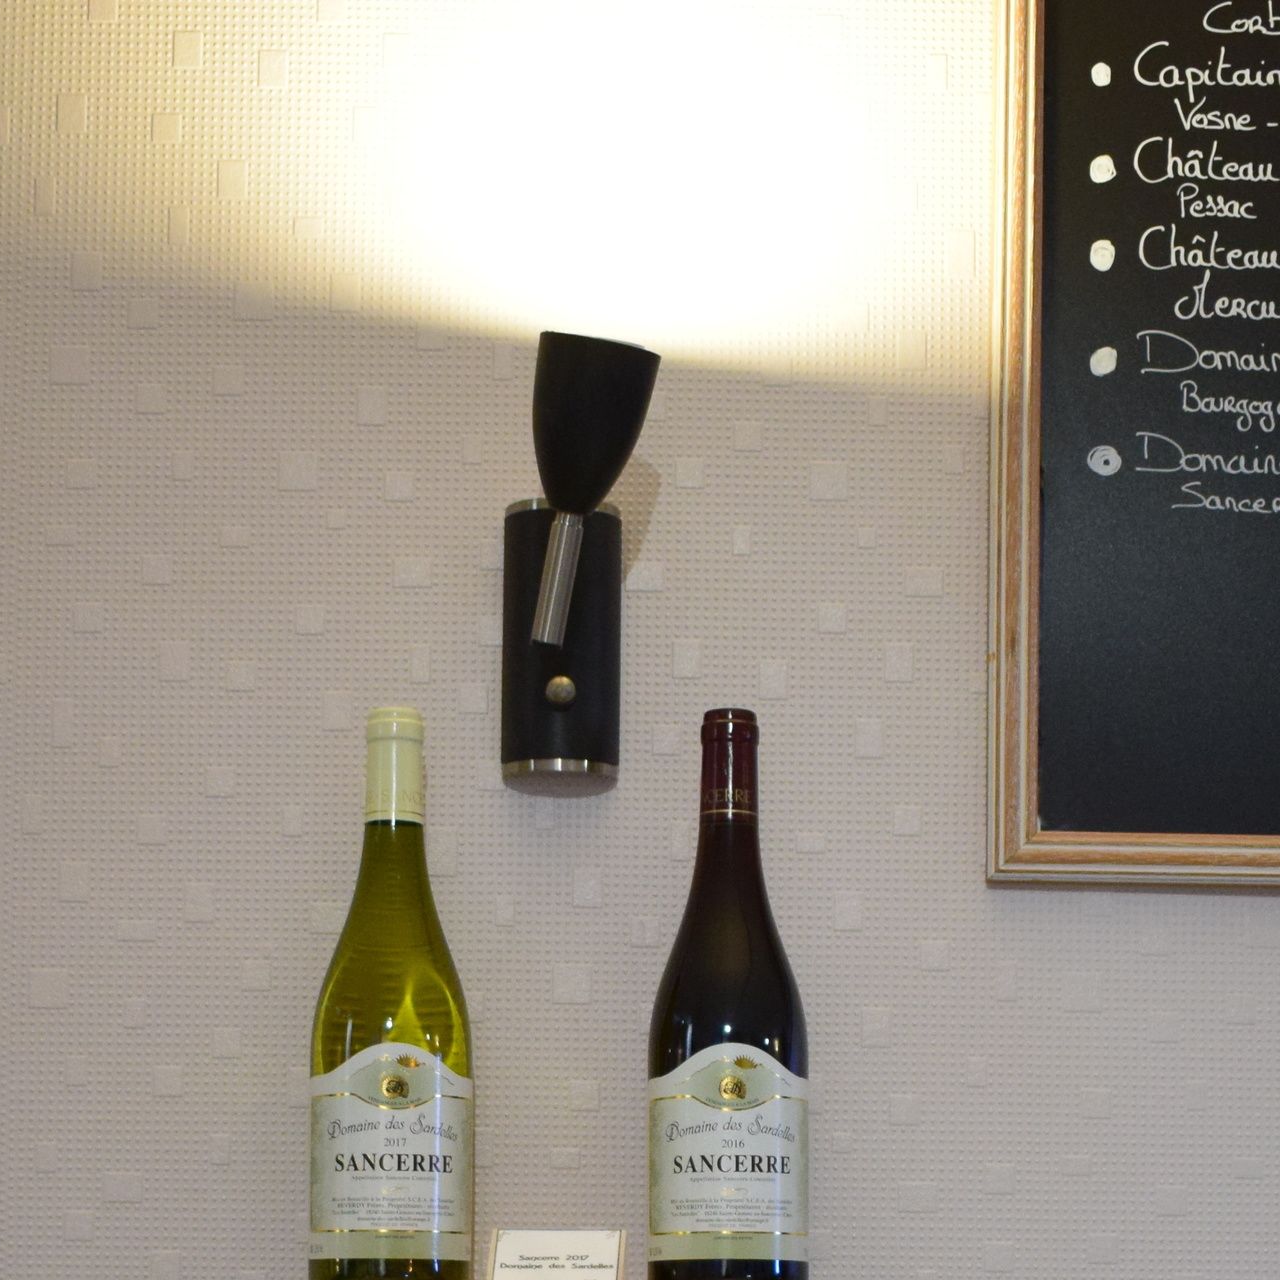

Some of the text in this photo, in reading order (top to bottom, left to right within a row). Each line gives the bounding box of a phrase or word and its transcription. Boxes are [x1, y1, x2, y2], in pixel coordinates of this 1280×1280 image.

[1134, 137, 1280, 183] Château
[1177, 184, 1257, 218] Pessac
[327, 1113, 458, 1142] Domaine des Sardelles
[665, 1114, 795, 1143] Domaine des Sardelles
[384, 1138, 407, 1147] 2017
[722, 1139, 745, 1149] 2016
[335, 1153, 453, 1173] SANCERRE
[673, 1154, 791, 1174] SANCERRE
